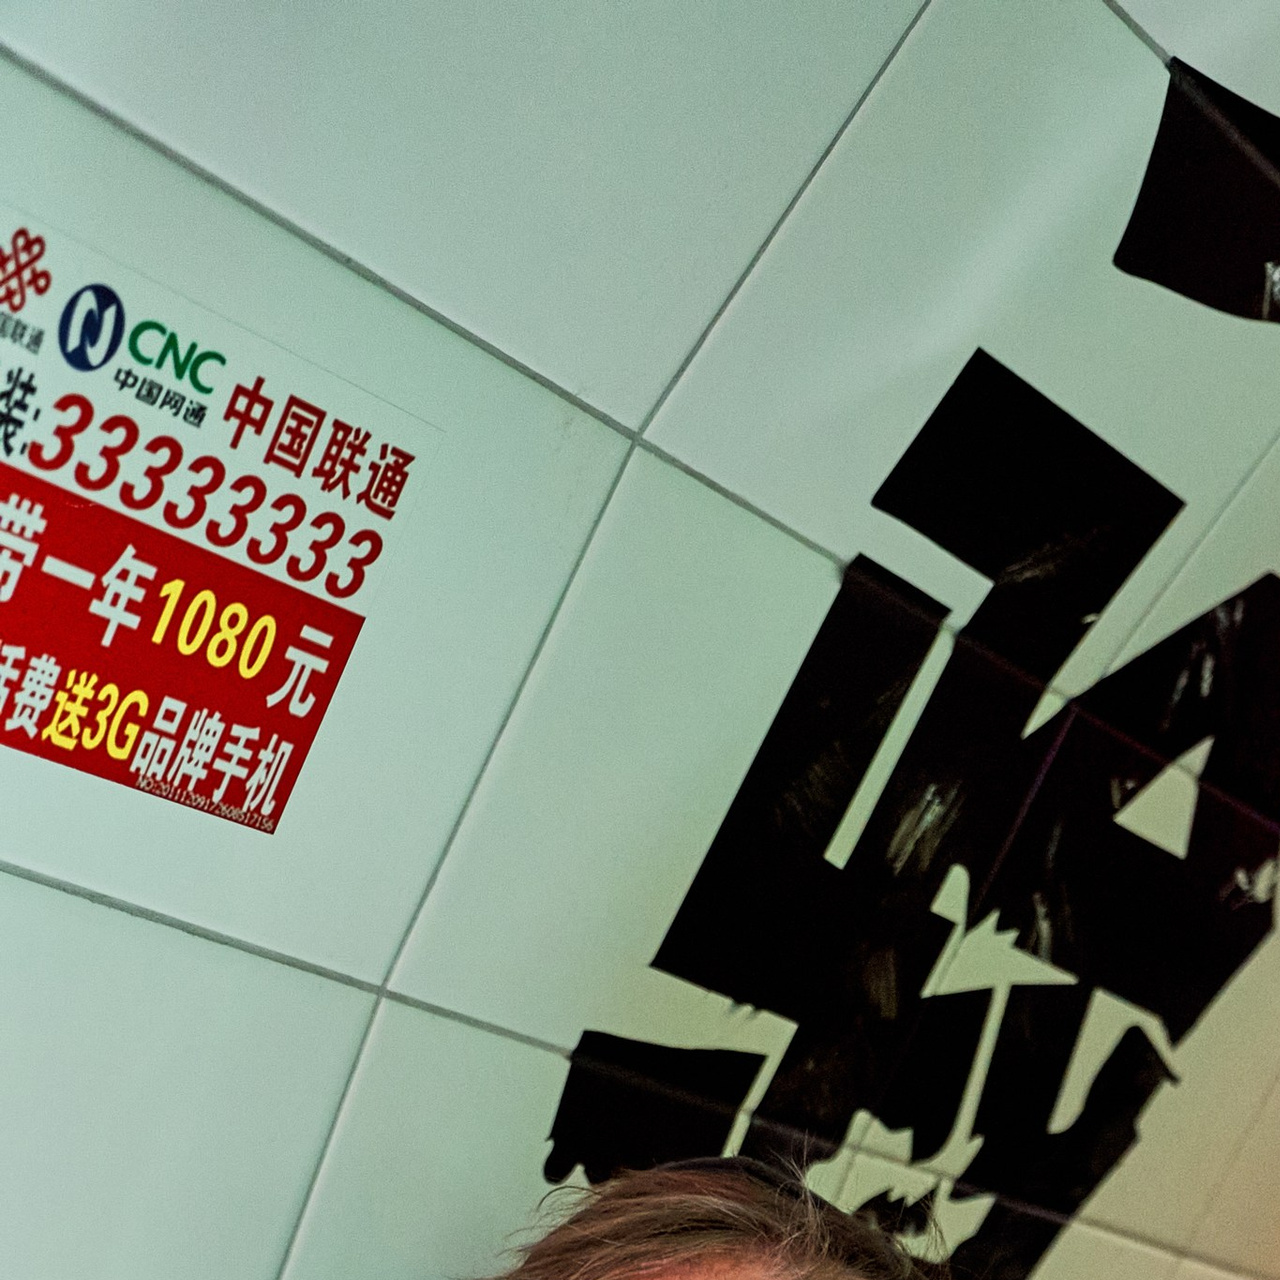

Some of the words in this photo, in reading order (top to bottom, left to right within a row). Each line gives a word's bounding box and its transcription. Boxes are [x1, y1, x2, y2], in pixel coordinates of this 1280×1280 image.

[128, 320, 227, 395] CNC
[113, 367, 208, 429] 中国网通
[222, 376, 417, 520] 中国联通
